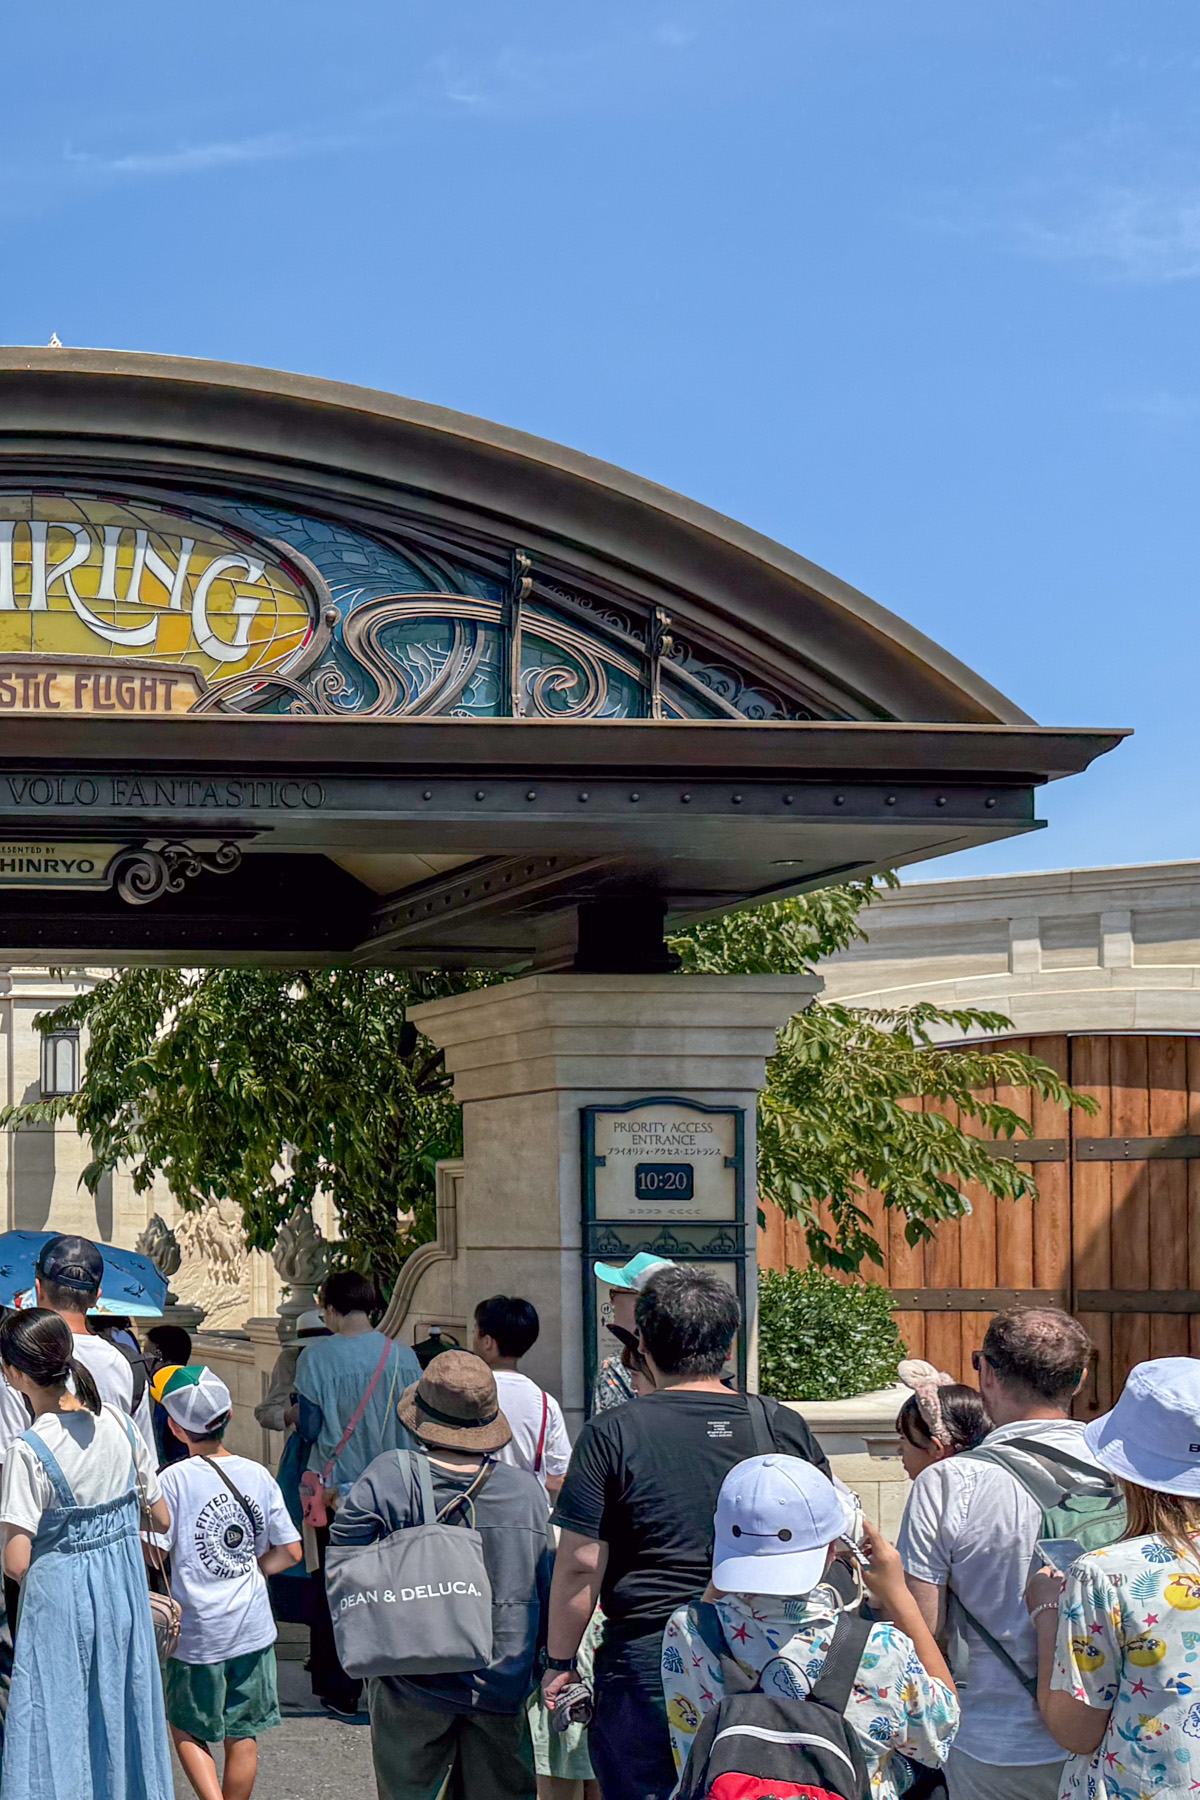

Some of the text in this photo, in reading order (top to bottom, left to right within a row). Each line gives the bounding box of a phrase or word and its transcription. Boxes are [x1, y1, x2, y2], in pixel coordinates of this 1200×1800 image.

[75, 674, 178, 711] FLIGHT
[6, 776, 100, 806] VOLO
[109, 778, 327, 808] FANTASTICO
[613, 1122, 713, 1133] PRIORITY ACCESS
[632, 1135, 696, 1146] ENTRANCE
[638, 1171, 687, 1190] 10:20
[196, 1493, 229, 1530] FITTED
[195, 1532, 213, 1570] TRUE
[212, 1565, 236, 1580] THE
[340, 1589, 379, 1611] DEAN
[383, 1589, 397, 1603] &
